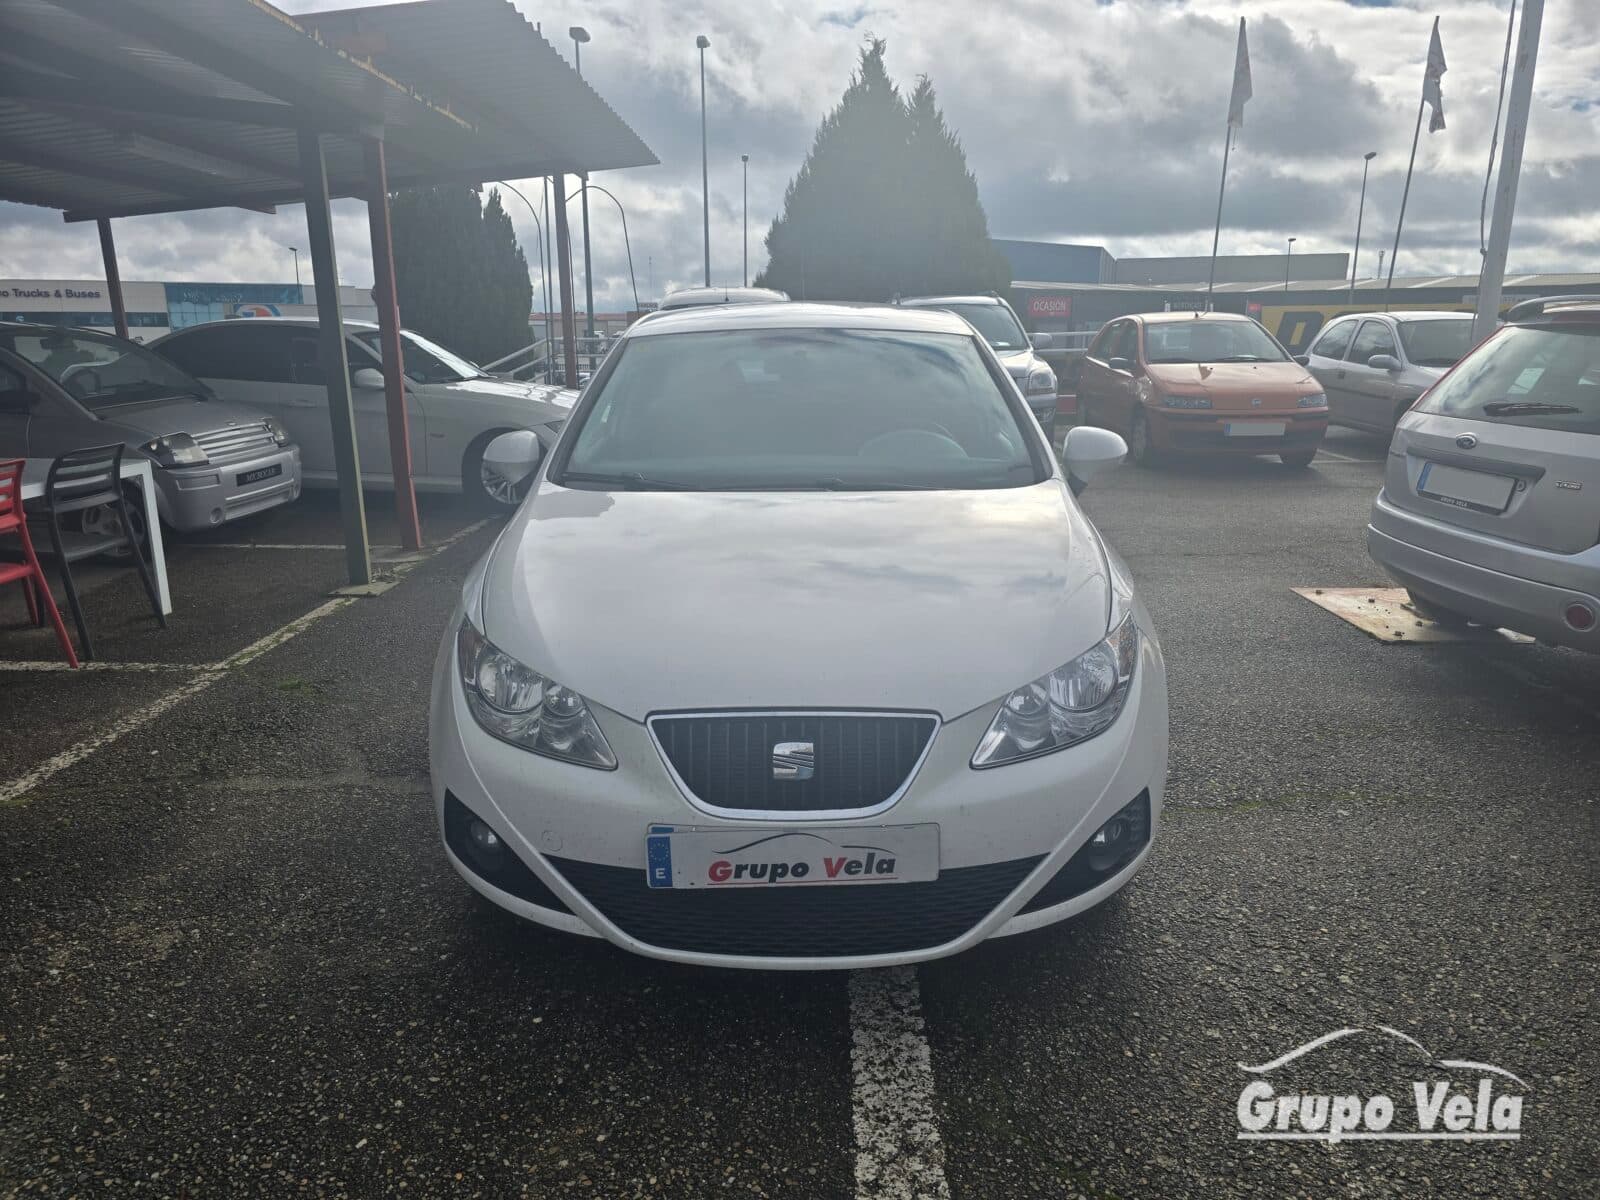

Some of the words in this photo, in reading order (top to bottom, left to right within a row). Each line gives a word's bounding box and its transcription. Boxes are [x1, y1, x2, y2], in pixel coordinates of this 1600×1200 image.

[12, 288, 50, 298] Trucks
[54, 289, 62, 298] &
[65, 288, 101, 298] Buses
[708, 860, 810, 883] Grupo
[823, 852, 897, 878] Vela
[655, 868, 667, 879] E
